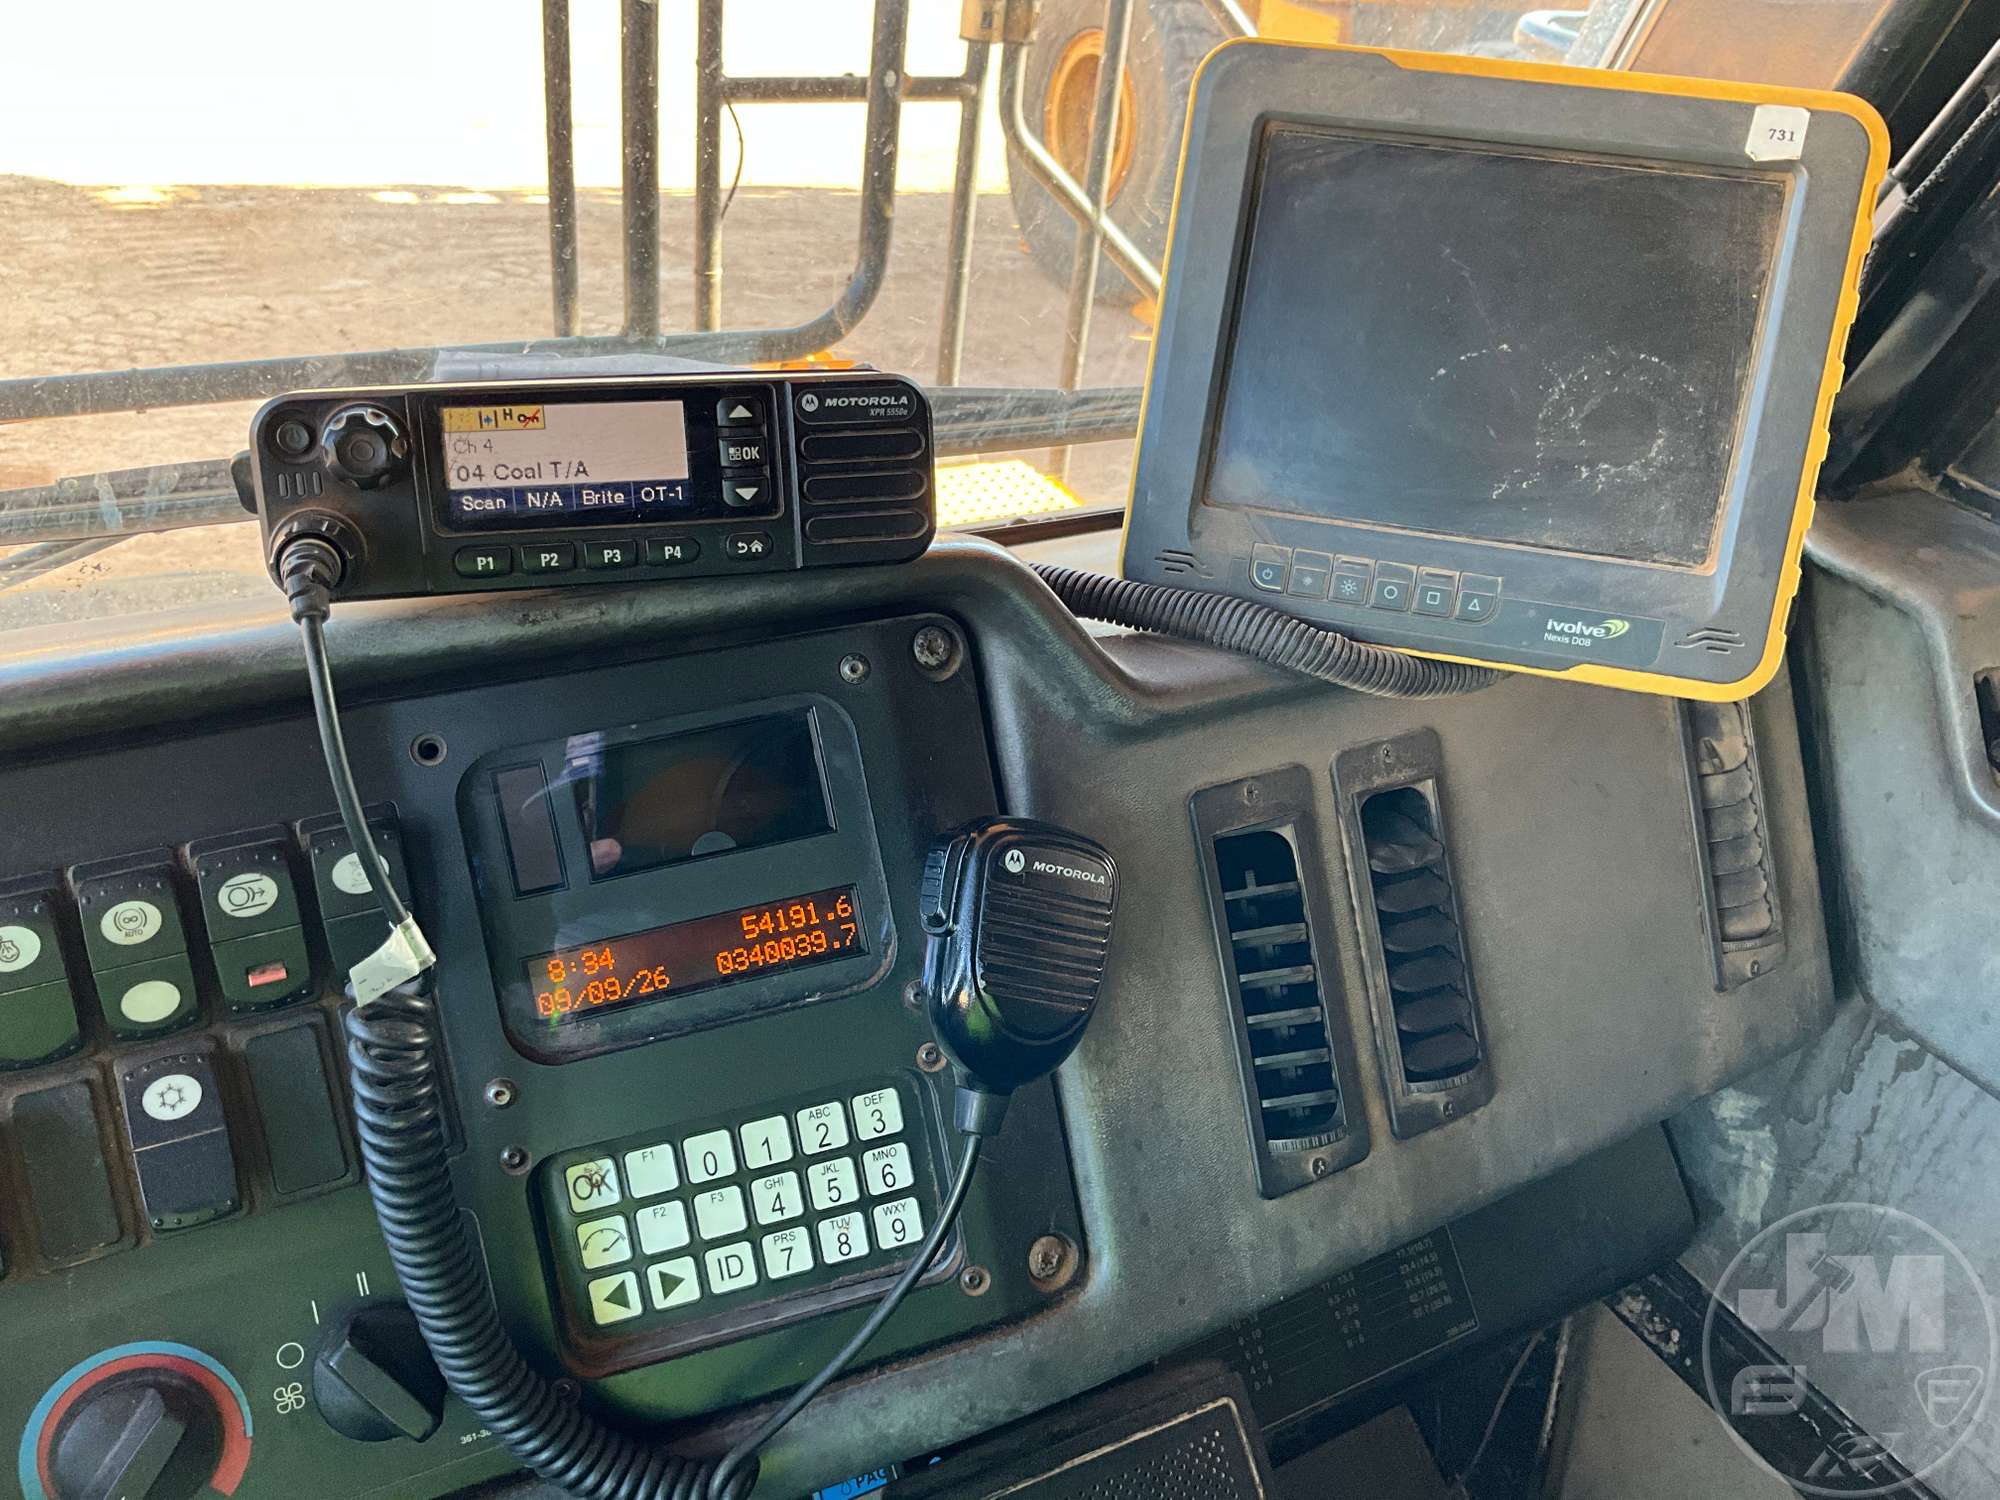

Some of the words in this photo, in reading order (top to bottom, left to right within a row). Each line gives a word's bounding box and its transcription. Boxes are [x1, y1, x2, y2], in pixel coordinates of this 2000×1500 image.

[1769, 128, 1795, 142] 731
[824, 396, 909, 407] MOTOROLA
[869, 408, 885, 416] XPR
[887, 408, 908, 416] 5550e
[453, 438, 477, 454] Ch
[483, 438, 493, 453] 4
[742, 446, 760, 460] OK
[456, 464, 485, 482] 04
[494, 462, 542, 481] Coal
[549, 460, 590, 479] T/A
[462, 495, 506, 511] Scan
[527, 491, 563, 508] N/A
[582, 489, 625, 505] Brite
[641, 486, 683, 502] OT-1
[540, 553, 560, 567] P2
[603, 549, 621, 563] P3
[664, 546, 682, 559] P4
[476, 557, 495, 571] P1
[1544, 632, 1569, 644] Nexis
[1571, 637, 1591, 647] D08
[1033, 861, 1105, 885] MOTOROLA
[741, 895, 853, 940] 54191.6
[716, 922, 856, 974] 0340039.7
[547, 947, 616, 983] 8:34
[538, 965, 670, 1015] 09/09/26
[863, 1093, 884, 1107] DEF
[808, 1107, 831, 1121] ABC
[871, 1109, 886, 1133] 3
[815, 1122, 832, 1148] 2
[761, 1136, 773, 1161] 1
[872, 1147, 897, 1162] MNO
[642, 1151, 655, 1162] F1
[703, 1151, 718, 1176] 0
[821, 1163, 840, 1176] JKL
[881, 1163, 896, 1188] 6
[764, 1176, 784, 1190] GHI
[827, 1178, 842, 1203] 5
[711, 1192, 724, 1204] F3
[771, 1192, 786, 1217] 4
[653, 1207, 667, 1219] F2
[882, 1202, 907, 1217] WXY
[830, 1217, 851, 1231] TUV
[891, 1218, 906, 1242] 9
[773, 1231, 796, 1246] PRS
[837, 1232, 852, 1256] 8
[780, 1246, 794, 1271] 7
[717, 1254, 744, 1281] ID
